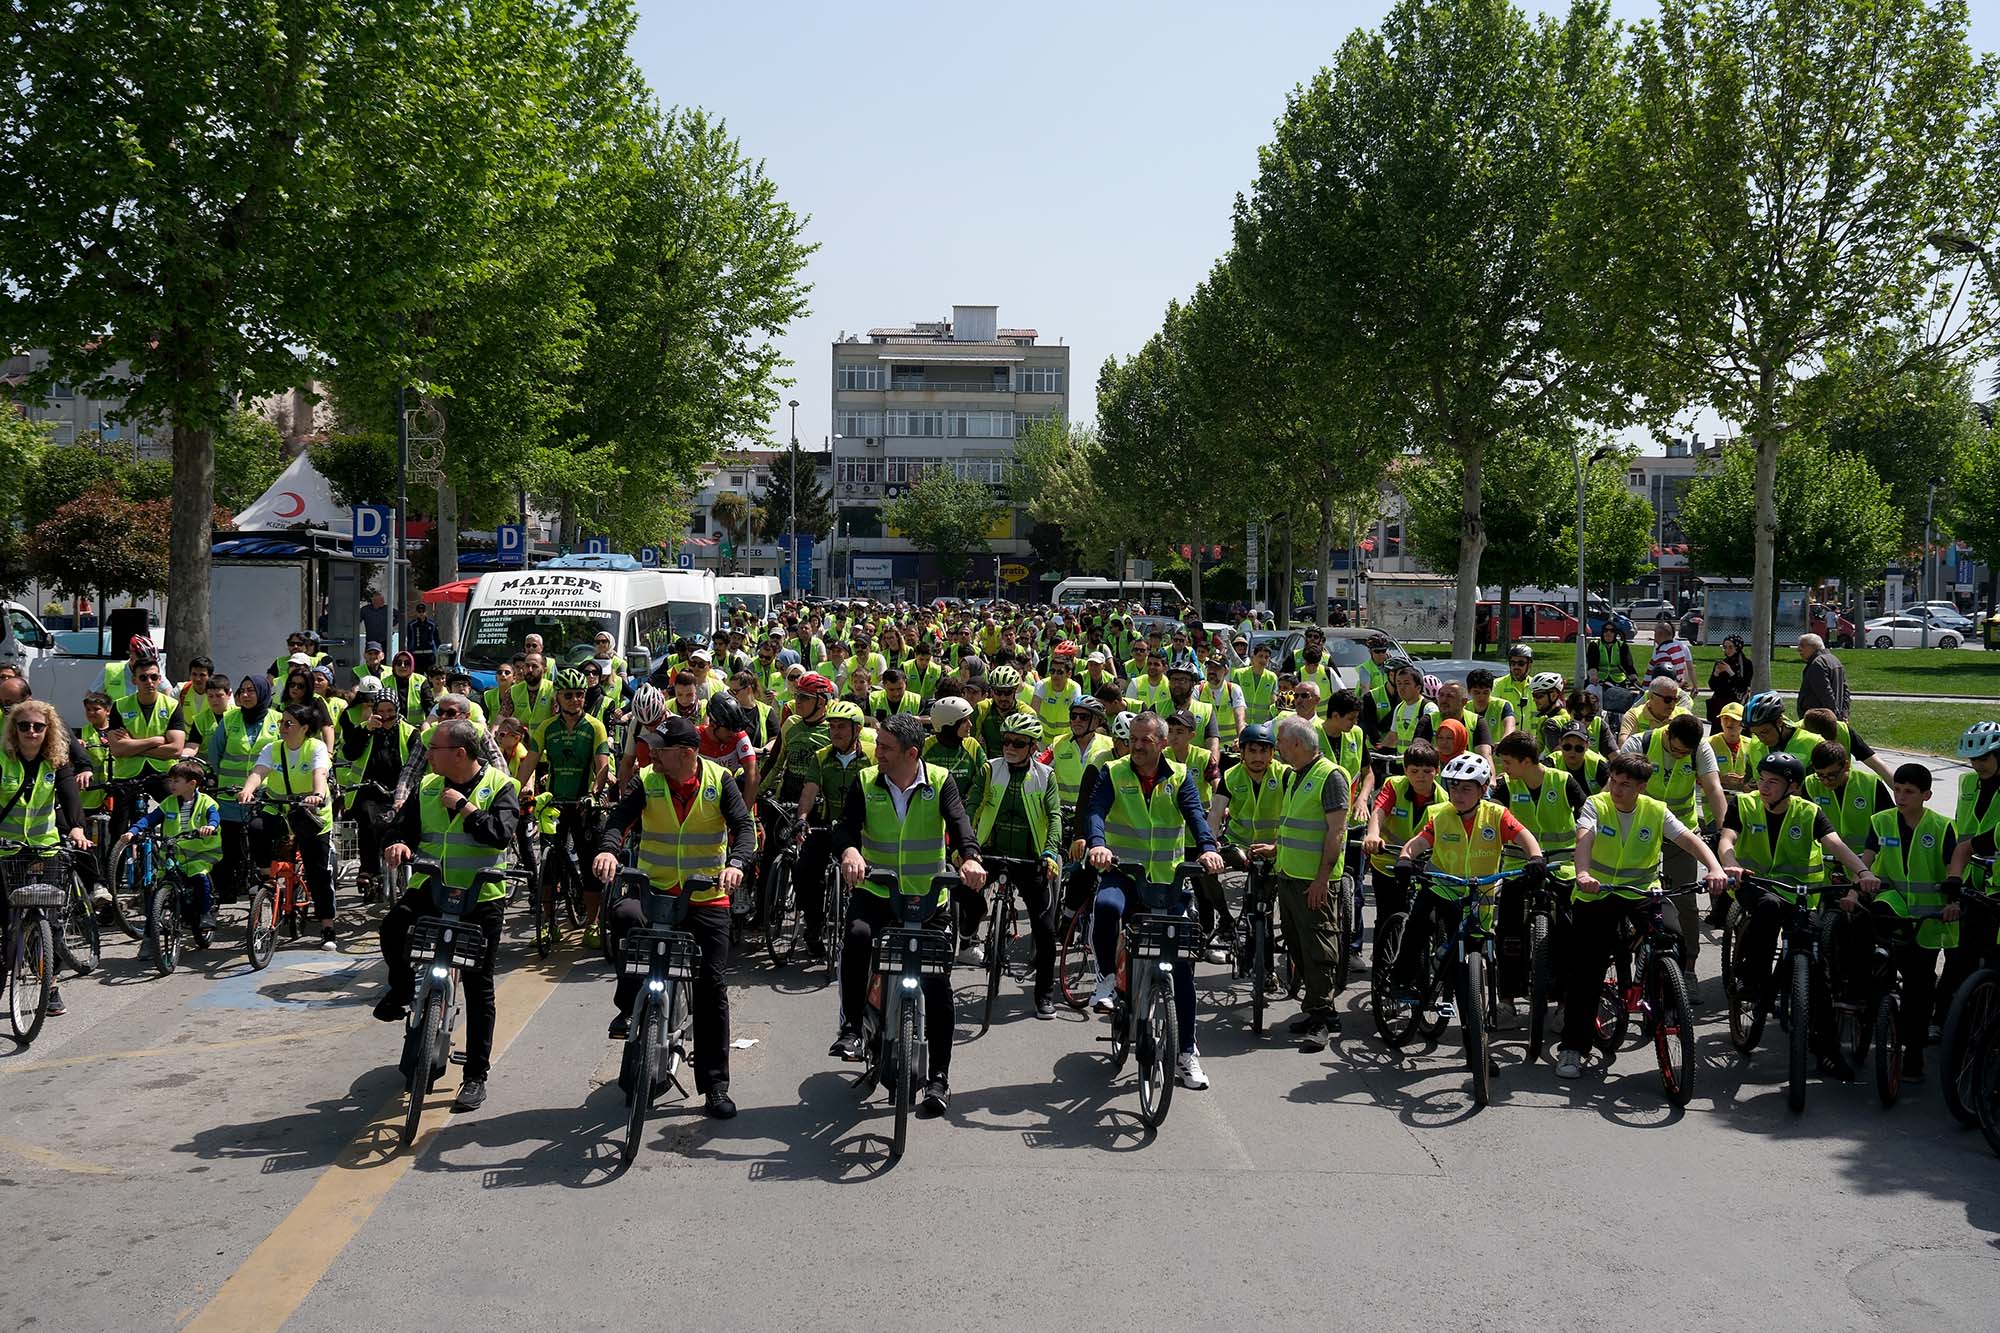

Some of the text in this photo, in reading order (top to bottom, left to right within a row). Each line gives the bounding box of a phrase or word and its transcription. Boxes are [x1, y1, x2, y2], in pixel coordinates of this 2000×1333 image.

[357, 508, 381, 536] D
[381, 533, 387, 544] 3
[503, 528, 517, 549] D
[642, 548, 654, 562] D
[681, 555, 689, 567] D
[1000, 567, 1025, 576] gratis
[500, 575, 602, 593] MALTEPE
[502, 607, 537, 616] DERİNCE
[538, 609, 587, 617] ARAÇLARINA
[588, 610, 612, 619] GİDER
